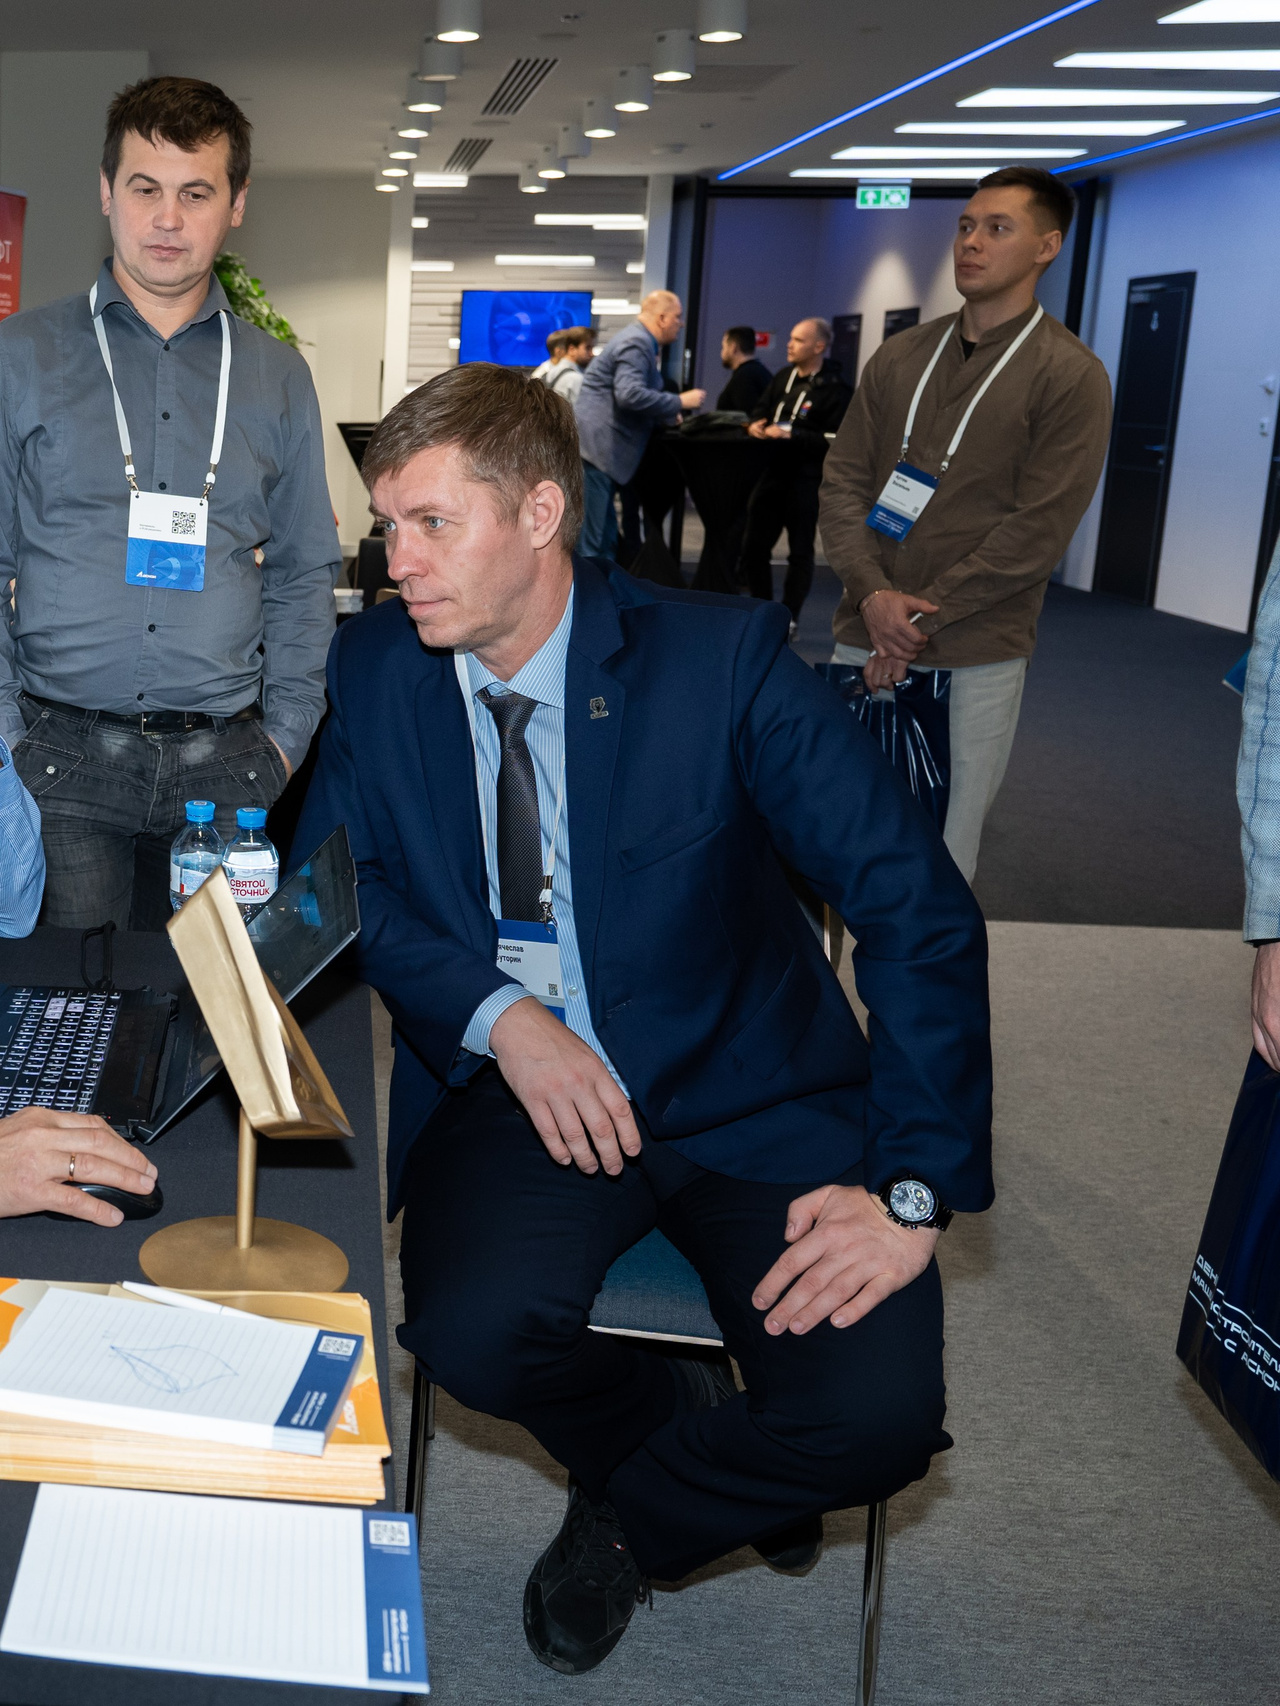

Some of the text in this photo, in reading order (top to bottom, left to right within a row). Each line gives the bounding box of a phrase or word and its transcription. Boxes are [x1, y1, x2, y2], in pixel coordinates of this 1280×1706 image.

[230, 879, 265, 887] СВЯТОЙ
[231, 888, 269, 896] СТОЧНИК
[498, 944, 524, 952] ячеслав
[1196, 1254, 1219, 1286] ДЕН
